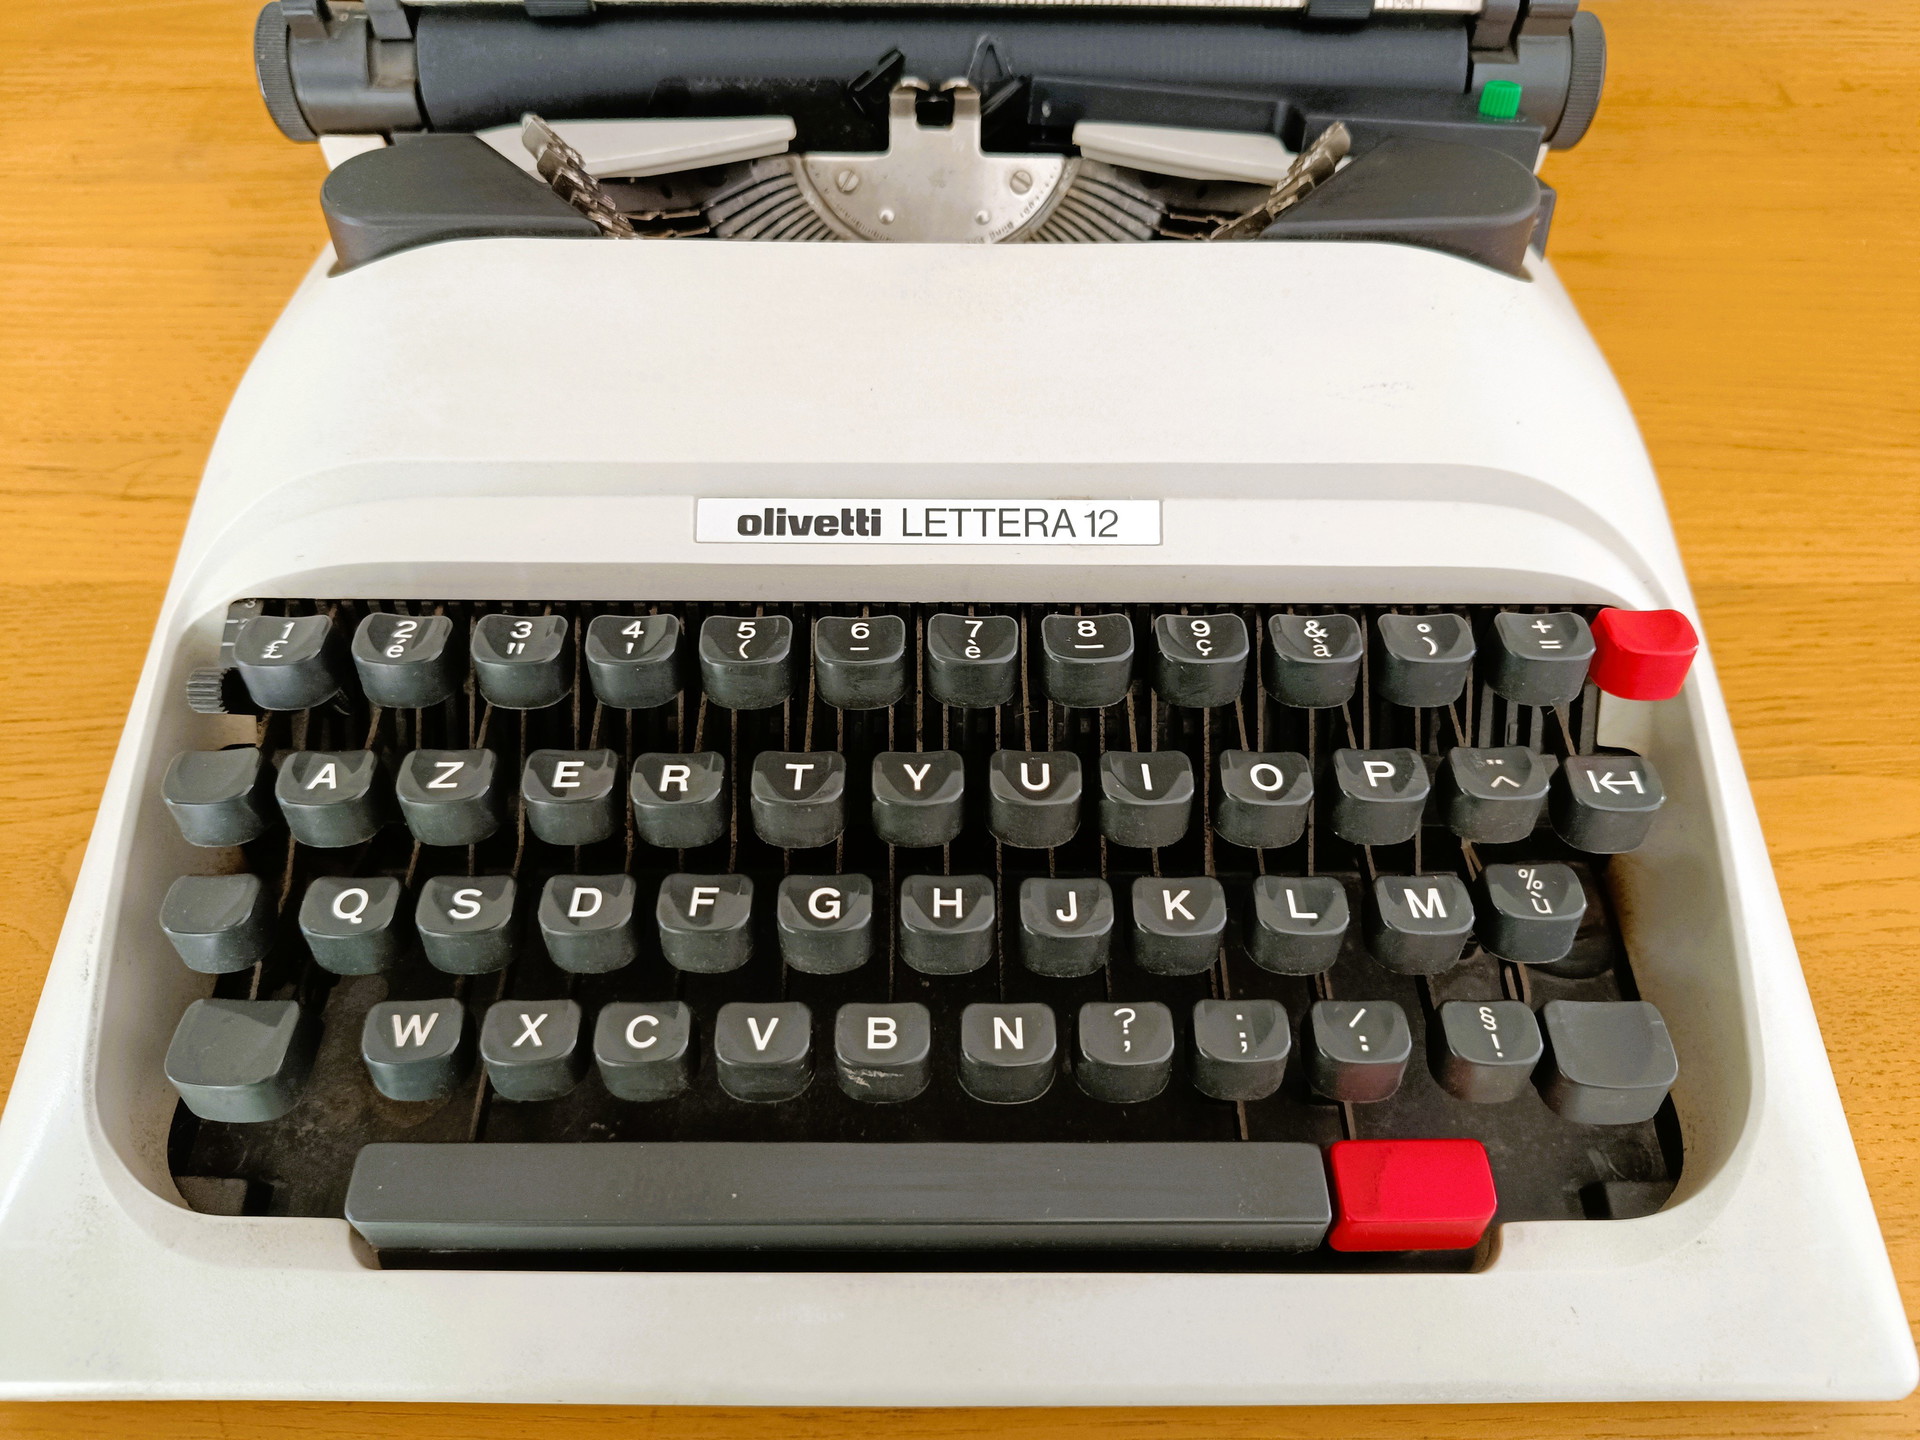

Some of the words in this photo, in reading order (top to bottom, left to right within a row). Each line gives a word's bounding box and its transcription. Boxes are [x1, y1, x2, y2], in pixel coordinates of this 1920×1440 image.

[738, 508, 881, 536] olivetti
[903, 508, 1076, 537] LETTERA
[1084, 509, 1119, 538] 12
[280, 622, 295, 639] 1
[394, 621, 417, 638] 2
[512, 622, 532, 638] 3
[622, 621, 644, 638] 4
[737, 622, 755, 638] 5
[851, 622, 870, 639] 6
[964, 620, 984, 638] 7
[1078, 621, 1096, 637] 8
[1191, 620, 1210, 637] 9
[1304, 620, 1328, 639] &
[1532, 621, 1551, 633] +
[387, 639, 406, 657] é
[738, 639, 749, 659] (
[965, 639, 981, 659] è
[1197, 639, 1213, 657] ç
[1313, 638, 1332, 657] à
[1423, 637, 1436, 655] )
[307, 764, 336, 789] A
[428, 762, 464, 788] Z
[553, 762, 584, 787] E
[660, 765, 690, 791] R
[786, 764, 814, 790] T
[904, 764, 930, 790] Y
[1021, 763, 1049, 790] U
[1141, 764, 1152, 790] I
[1250, 764, 1283, 791] O
[1364, 761, 1394, 786] P
[1518, 869, 1542, 889] %
[333, 889, 368, 923] Q
[449, 889, 482, 919] S
[569, 888, 602, 917] D
[689, 887, 719, 916] F
[809, 888, 840, 918] G
[934, 888, 962, 918] H
[1057, 892, 1077, 921] J
[1163, 890, 1195, 920] K
[1286, 890, 1317, 918] L
[1404, 888, 1446, 918] M
[1530, 891, 1552, 914] ù
[393, 1013, 438, 1046] W
[513, 1014, 547, 1046] X
[1114, 1008, 1135, 1034] ?
[1349, 1009, 1365, 1027] /
[1479, 1007, 1496, 1030] §
[626, 1015, 659, 1048] C
[748, 1018, 778, 1050] V
[868, 1017, 897, 1049] B
[994, 1017, 1023, 1049] N
[1240, 1033, 1247, 1052] ;
[1359, 1036, 1368, 1051] :
[1492, 1034, 1502, 1057] !
